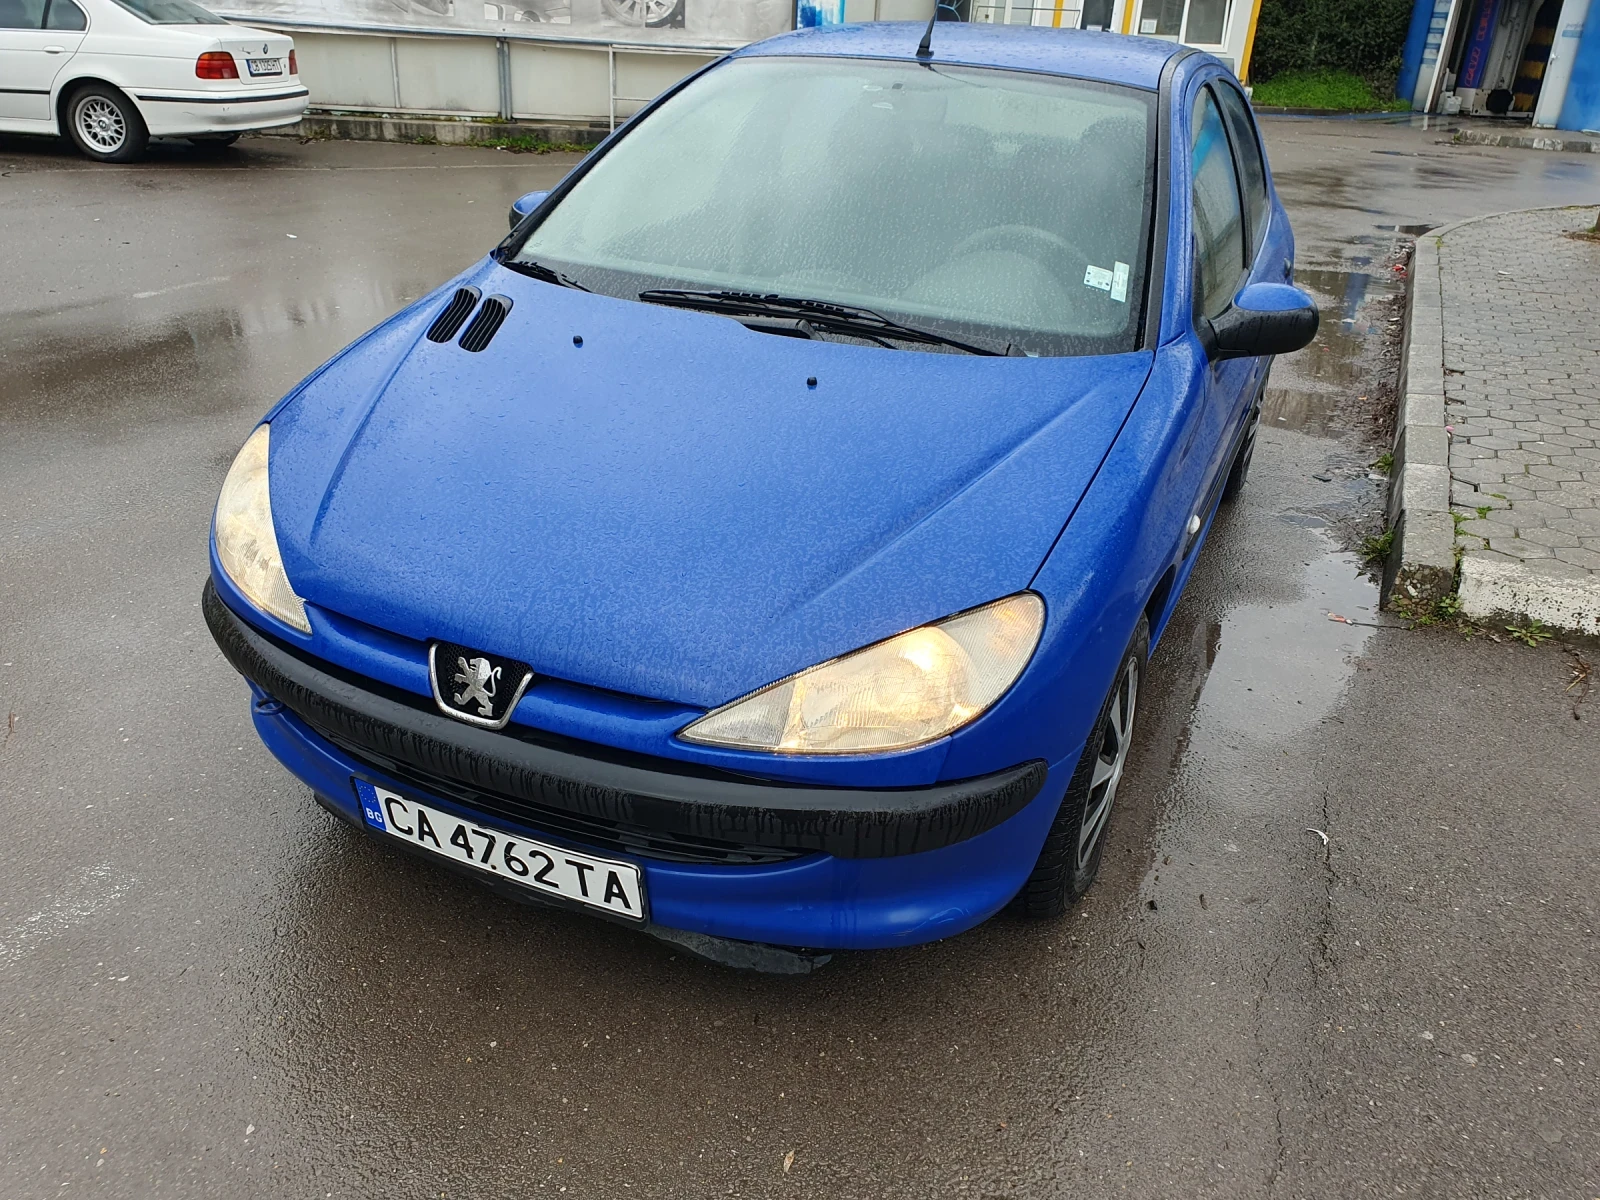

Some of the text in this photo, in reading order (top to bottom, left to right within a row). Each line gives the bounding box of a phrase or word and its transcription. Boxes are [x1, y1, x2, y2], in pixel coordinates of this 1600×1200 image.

[365, 807, 383, 823] BG
[384, 797, 632, 910] CA 4762 TA
